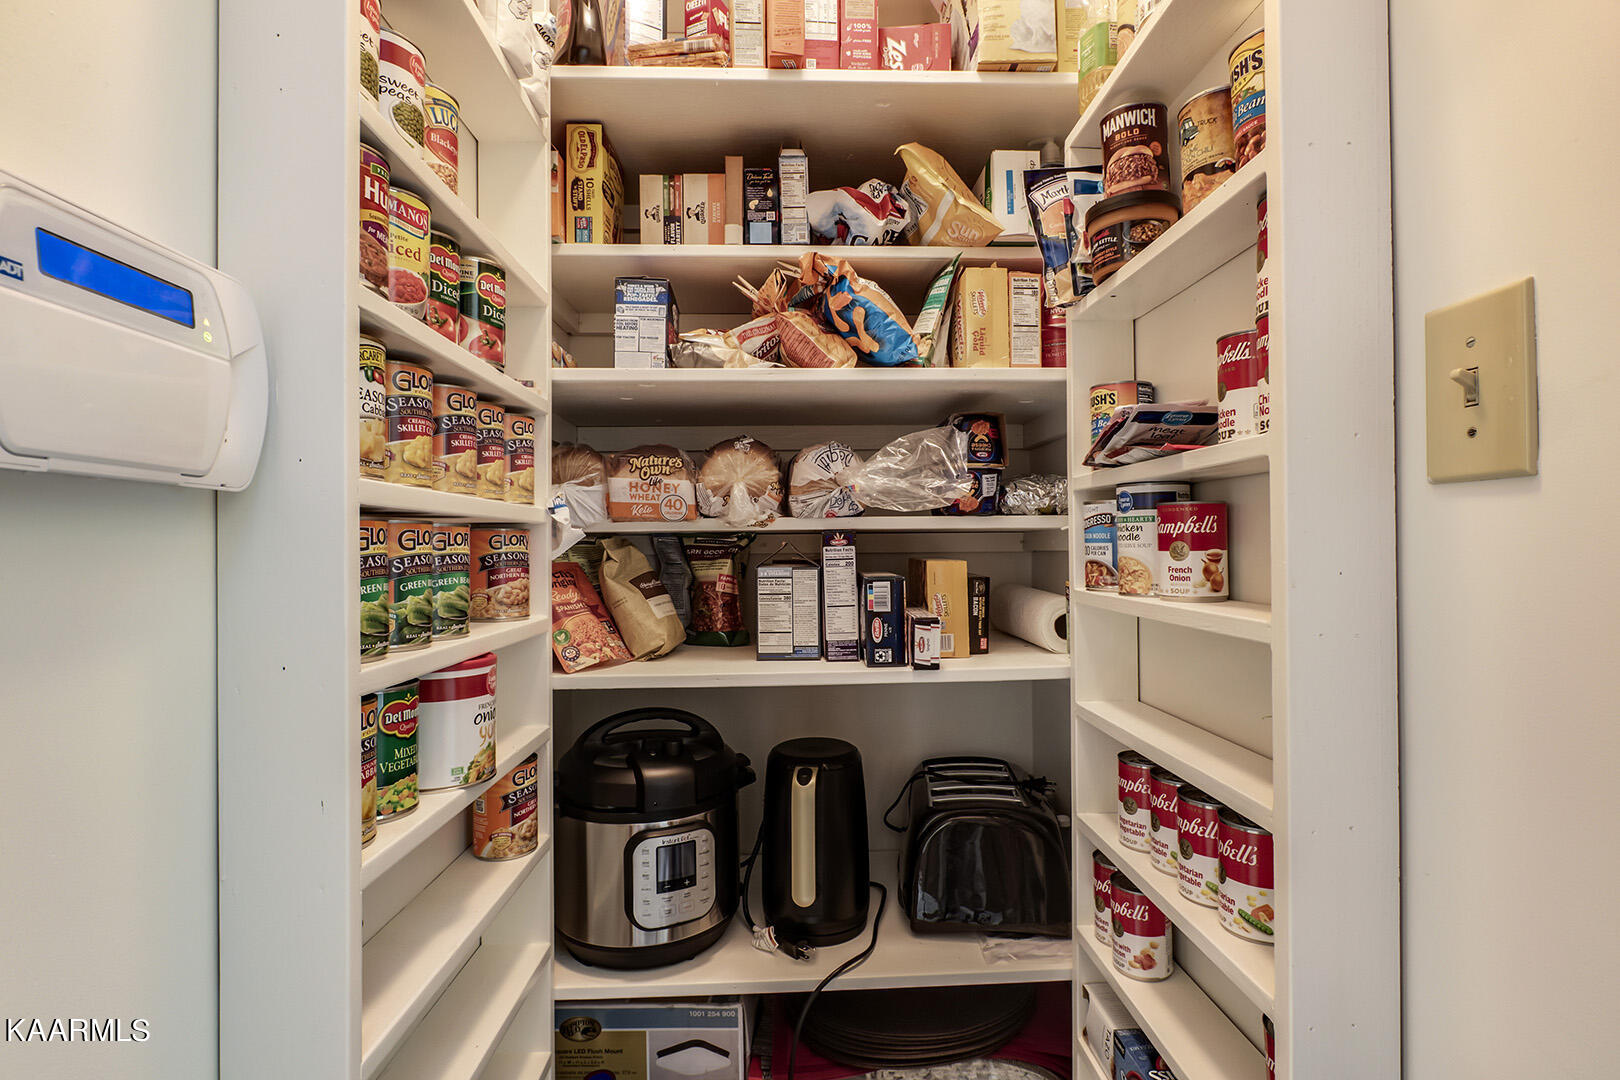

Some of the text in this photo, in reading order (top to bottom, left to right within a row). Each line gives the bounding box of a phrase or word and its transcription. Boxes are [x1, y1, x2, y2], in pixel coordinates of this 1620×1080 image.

[1232, 49, 1263, 84] SH'S
[379, 75, 419, 100] sweet
[379, 85, 412, 105] peas
[1103, 109, 1157, 142] MANWICH
[1115, 128, 1140, 142] BOLD
[586, 177, 594, 188] 10
[430, 253, 444, 266] Del
[0, 259, 23, 276] ADT
[480, 280, 493, 292] Del
[978, 328, 986, 356] Liquid
[629, 454, 683, 473] Nature's
[640, 465, 670, 480] Own
[629, 482, 681, 494] HONEY
[629, 493, 661, 501] WHEAT
[630, 504, 653, 516] Keto
[664, 499, 683, 511] 40
[1168, 566, 1192, 574] French
[1169, 574, 1191, 582] Onion
[400, 580, 427, 591] GREEN
[385, 711, 402, 724] Del
